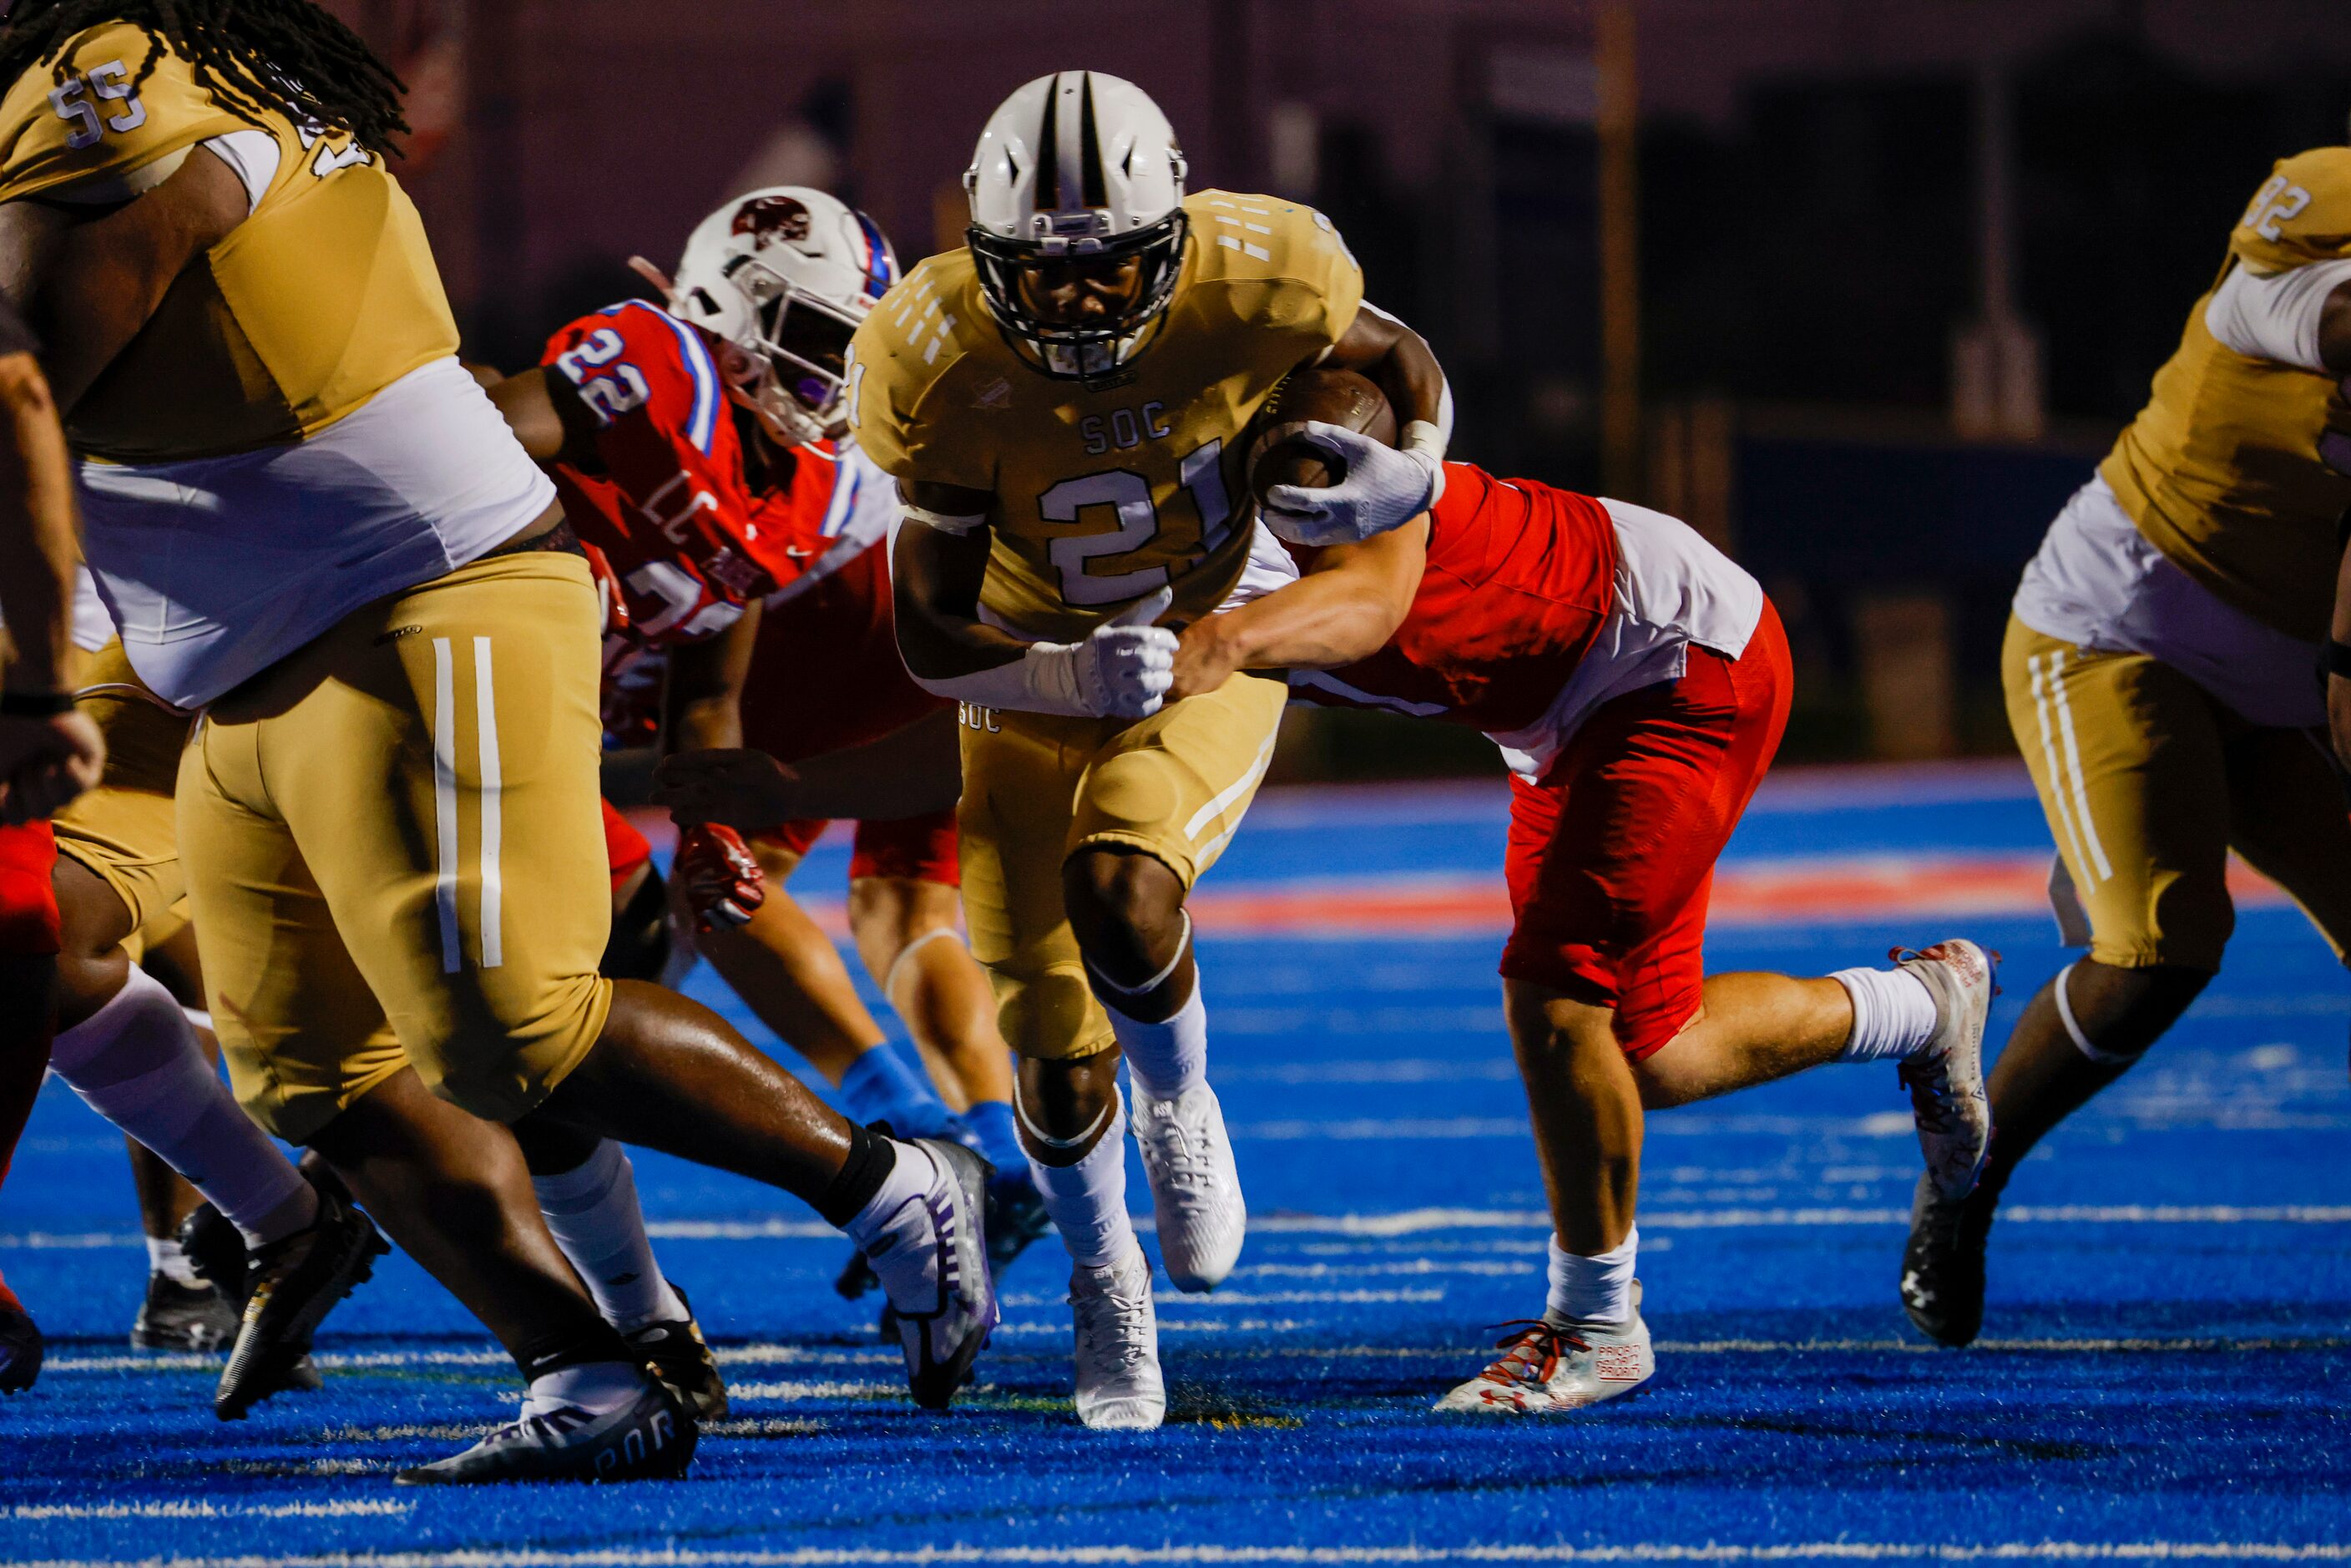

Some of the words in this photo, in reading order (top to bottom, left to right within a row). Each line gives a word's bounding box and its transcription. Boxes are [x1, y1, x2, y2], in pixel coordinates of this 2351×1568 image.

[48, 59, 147, 149] 55
[557, 327, 651, 426] 22
[1082, 400, 1170, 453] SOC
[1036, 436, 1232, 606] 21
[959, 700, 1001, 733] SOC
